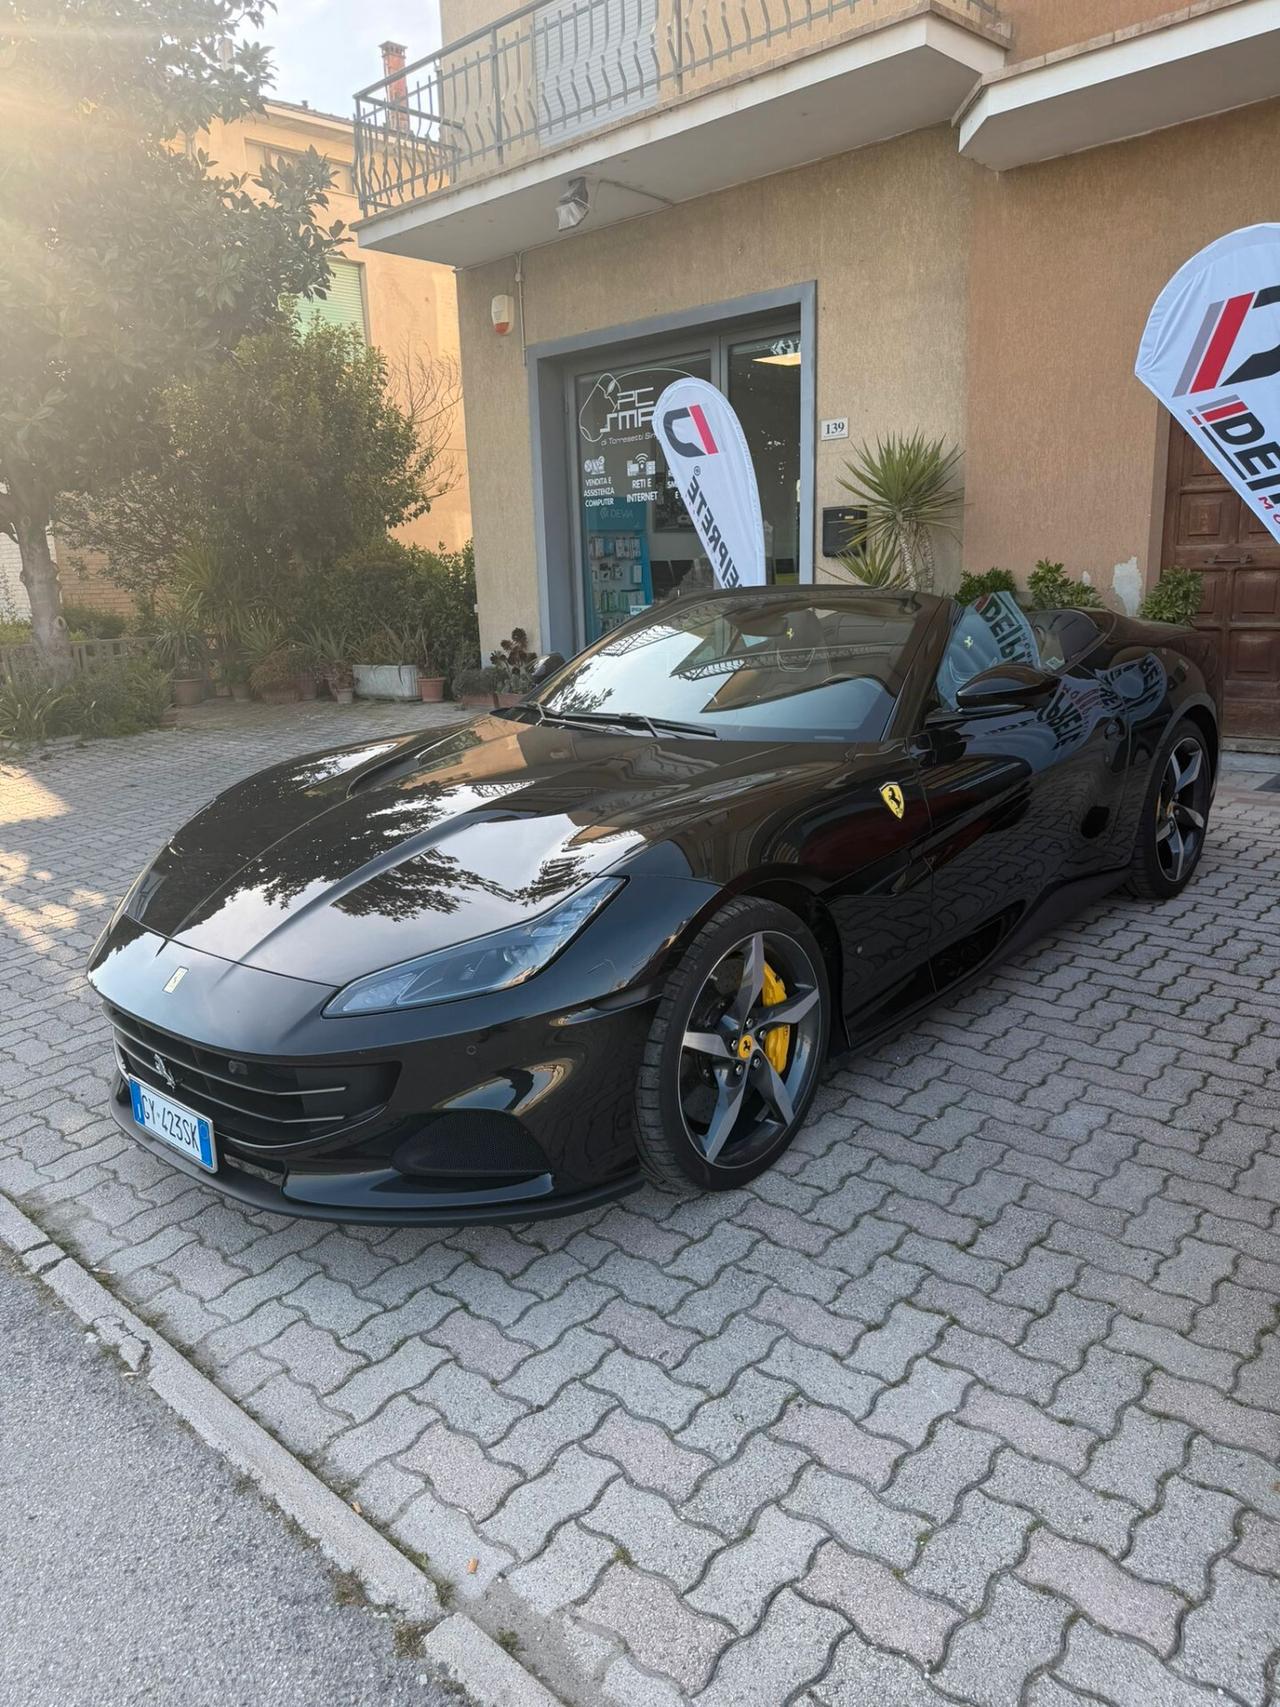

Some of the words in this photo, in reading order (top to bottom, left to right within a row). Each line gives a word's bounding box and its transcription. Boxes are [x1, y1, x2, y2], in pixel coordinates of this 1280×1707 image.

[616, 387, 654, 410] PC
[825, 421, 845, 435] 139
[585, 477, 608, 487] VENDITA
[608, 476, 612, 485] E
[631, 479, 646, 489] RETI
[647, 478, 652, 487] E
[583, 487, 615, 498] ASSISTENZA
[626, 491, 658, 503] INTERNET
[584, 497, 614, 507] COMPUTER
